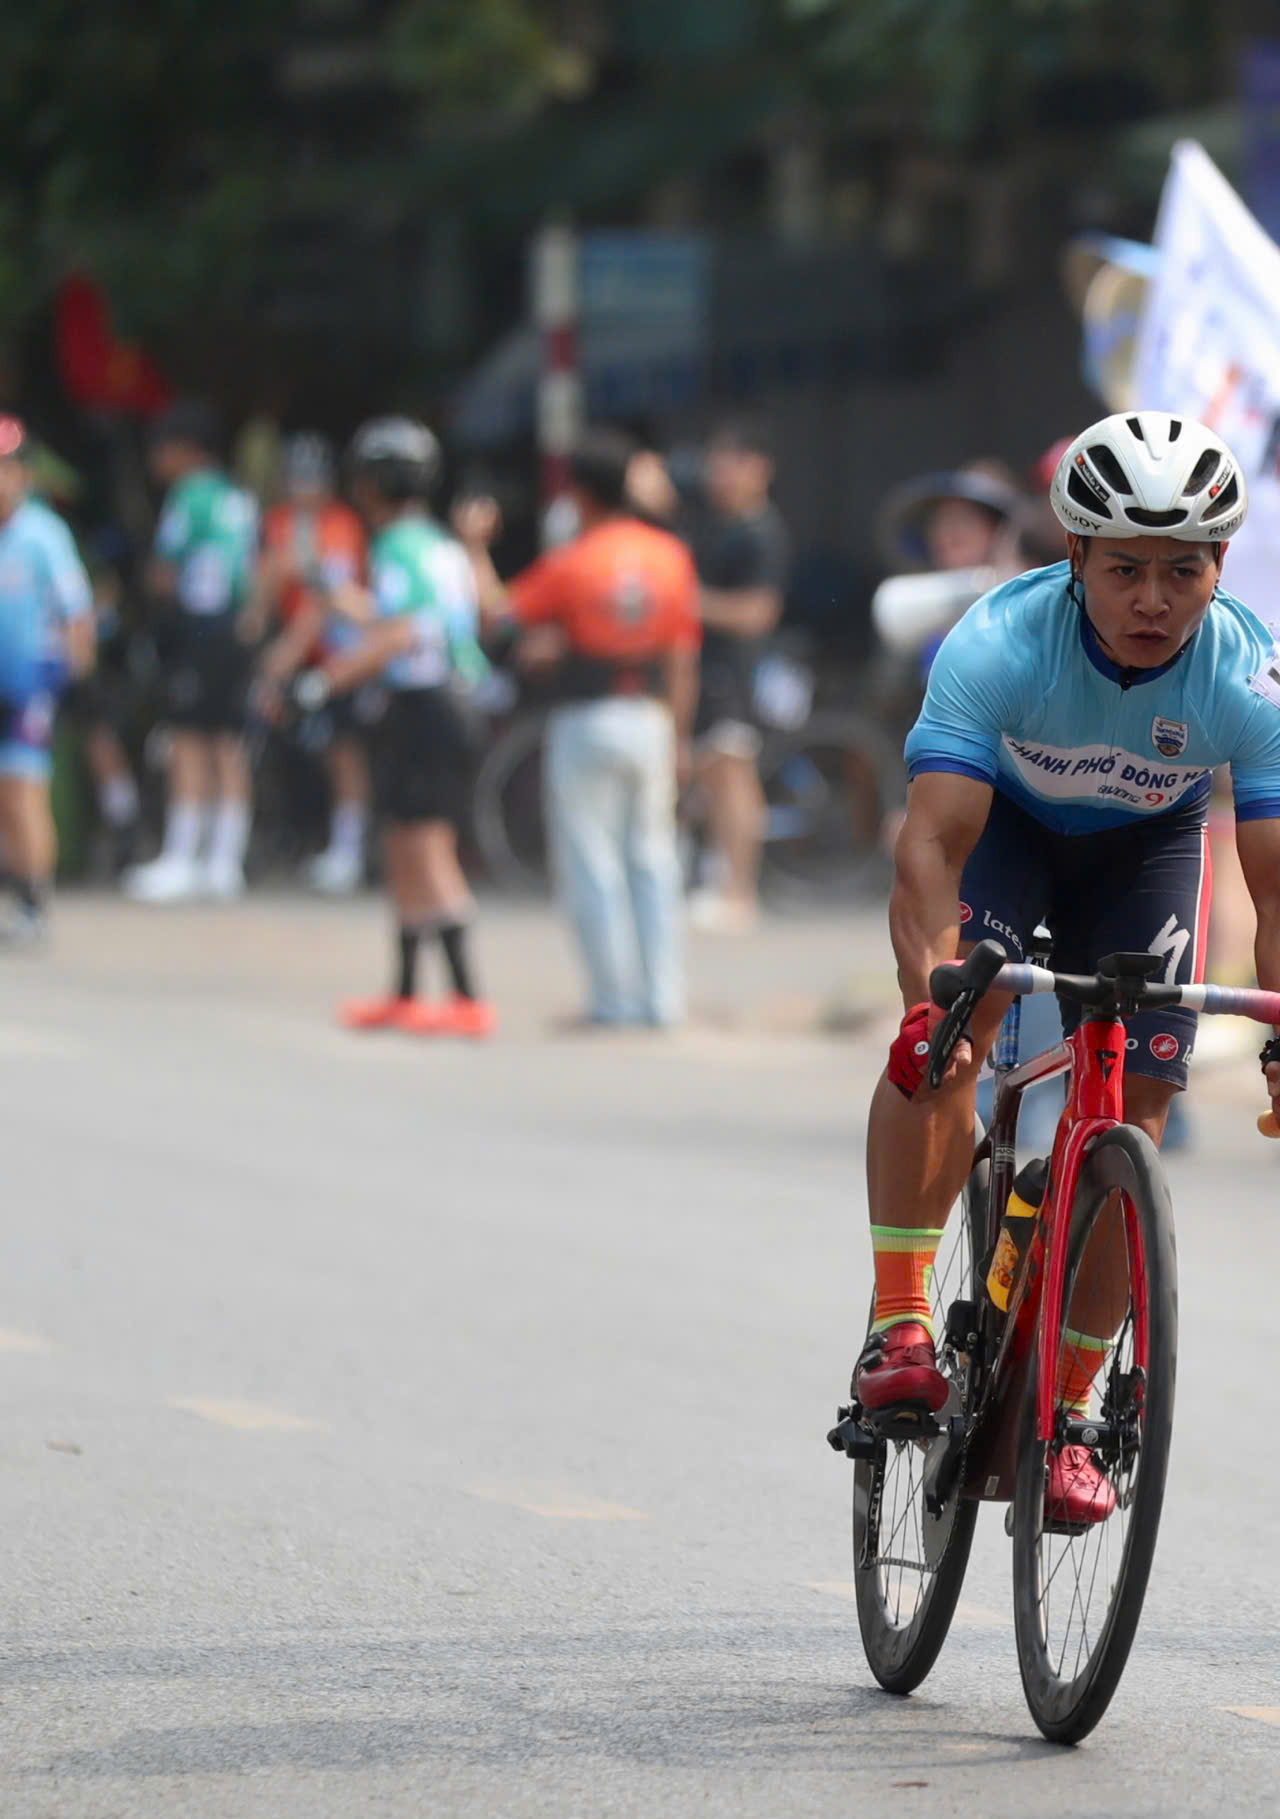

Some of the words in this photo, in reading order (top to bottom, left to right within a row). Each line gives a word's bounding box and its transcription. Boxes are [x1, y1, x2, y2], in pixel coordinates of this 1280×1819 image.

[1070, 752, 1122, 776] PHỐ
[1120, 764, 1178, 789] ĐÔNG
[1145, 792, 1164, 807] 9
